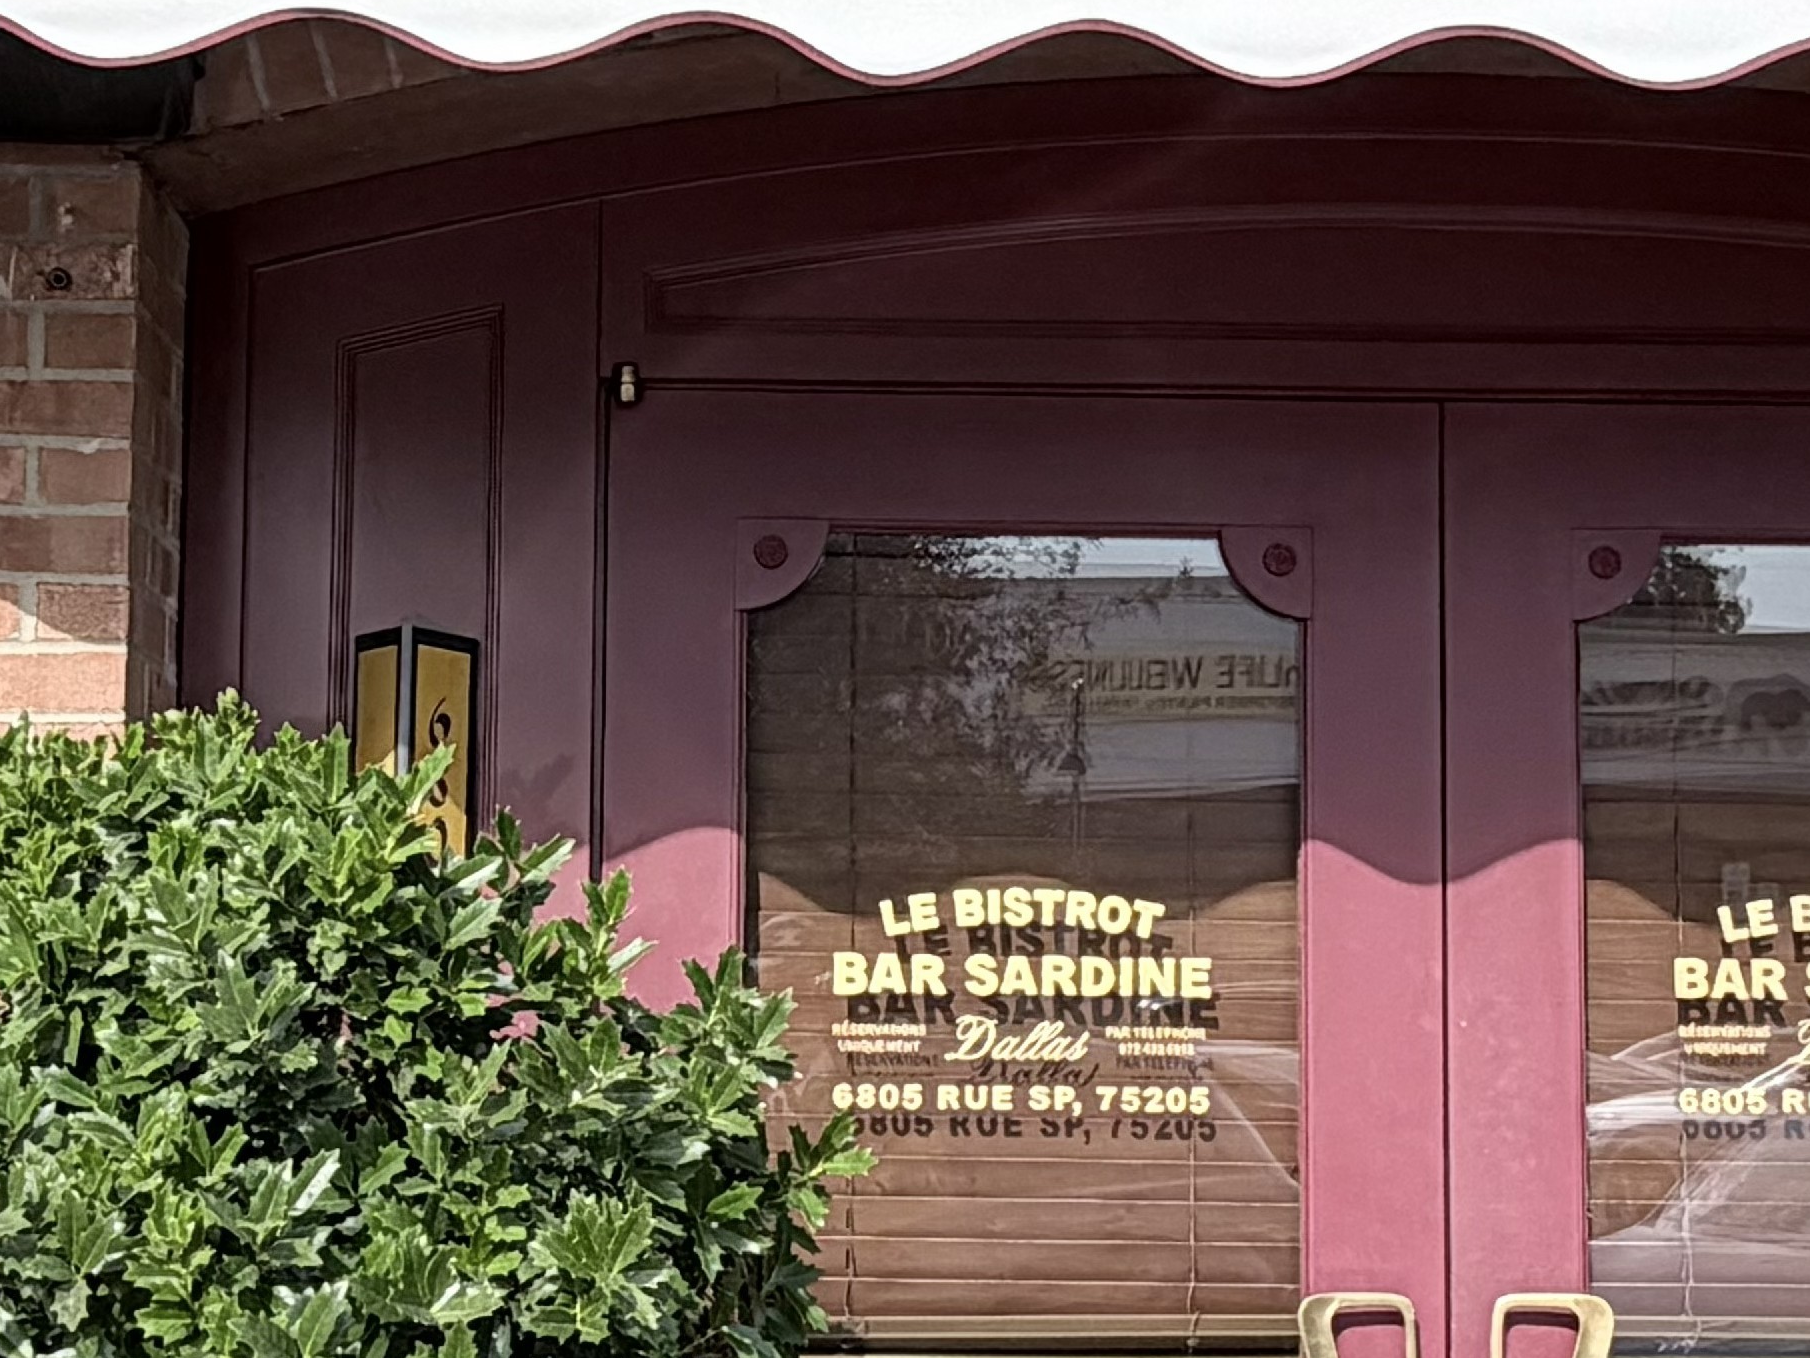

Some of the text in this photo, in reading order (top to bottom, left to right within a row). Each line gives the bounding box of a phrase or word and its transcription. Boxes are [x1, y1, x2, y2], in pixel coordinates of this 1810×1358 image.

[879, 887, 1166, 939] LE BISTROT
[1717, 899, 1779, 943] LE
[832, 951, 1213, 999] BAR SARDINE
[1673, 957, 1788, 1001] BAR
[944, 1014, 1091, 1062] Dallas
[832, 1083, 1211, 1117] 6805 RUE SP, 75205
[1678, 1087, 1767, 1116] 6805
